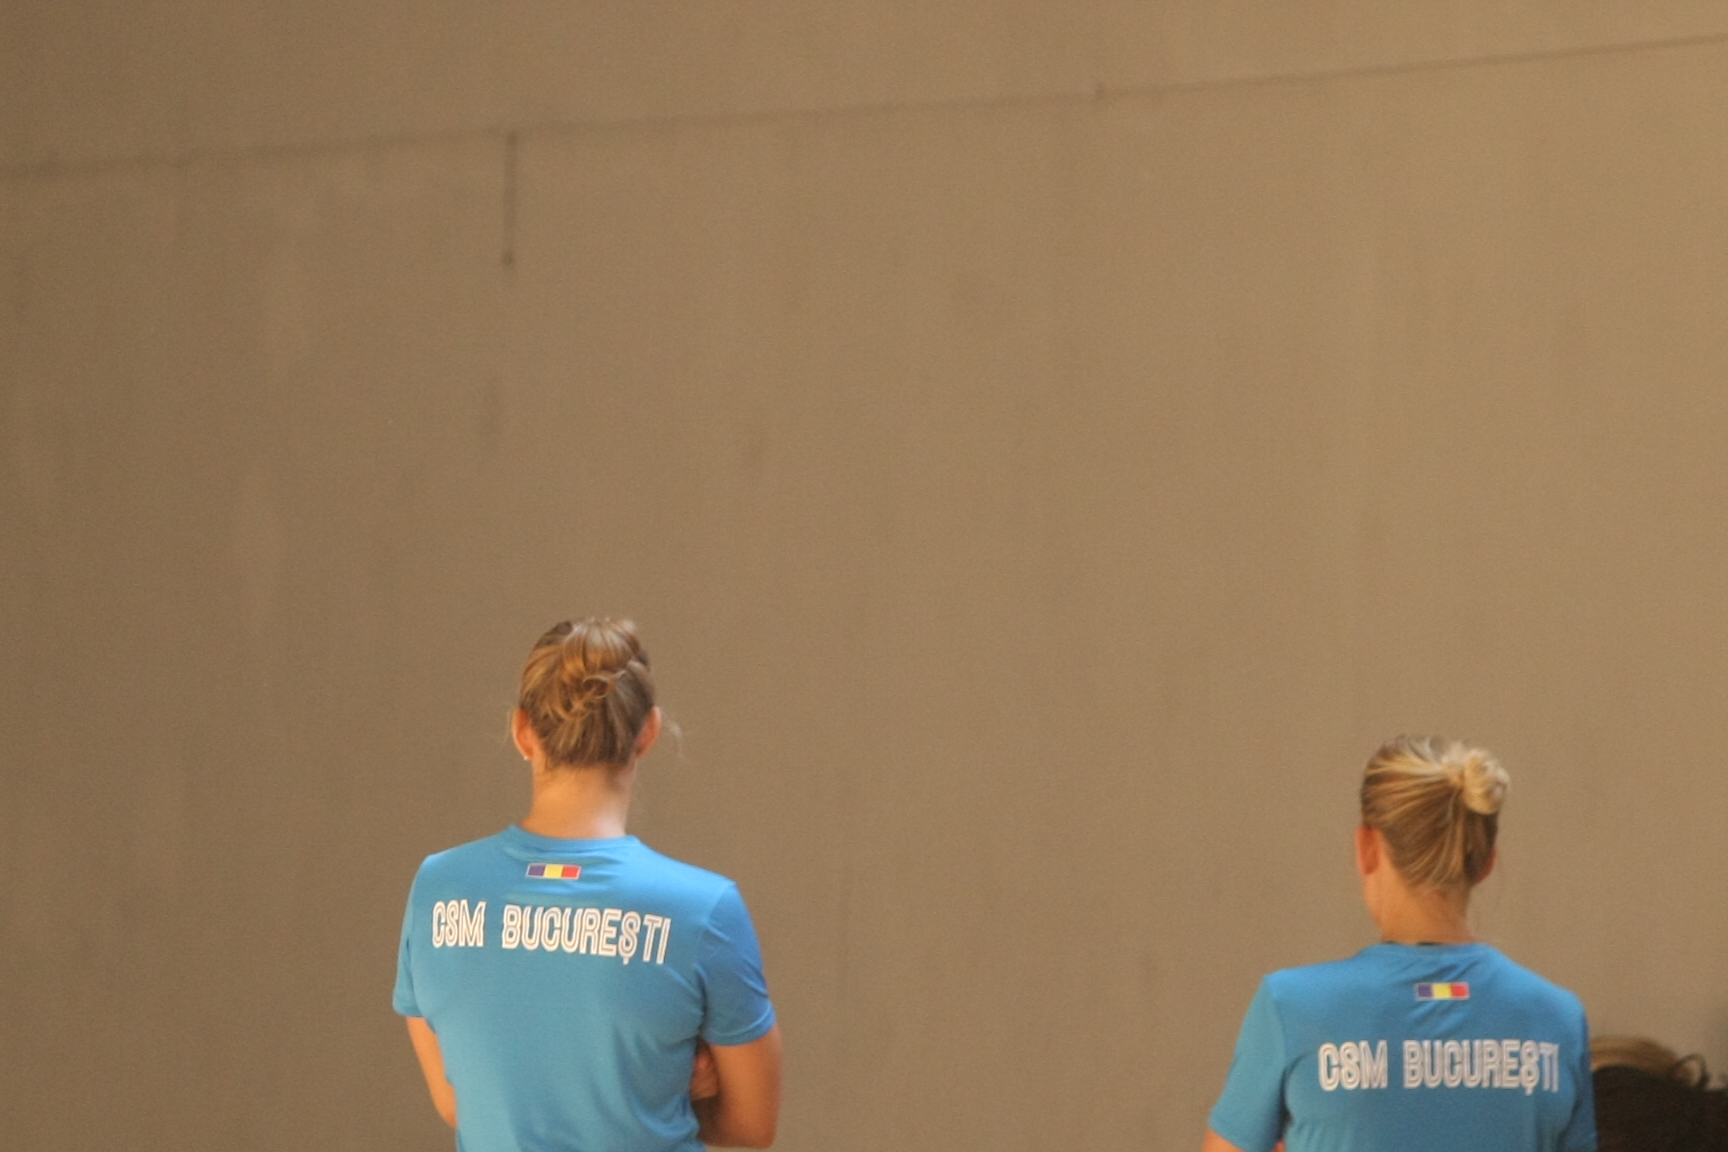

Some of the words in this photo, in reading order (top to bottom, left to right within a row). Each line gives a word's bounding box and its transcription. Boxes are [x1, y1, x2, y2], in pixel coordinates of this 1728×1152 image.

[432, 899, 486, 948] CSM
[502, 904, 671, 965] BUCUREȘTI
[1318, 1040, 1388, 1092] CSM
[1403, 1038, 1559, 1096] BUCUREȘTI
